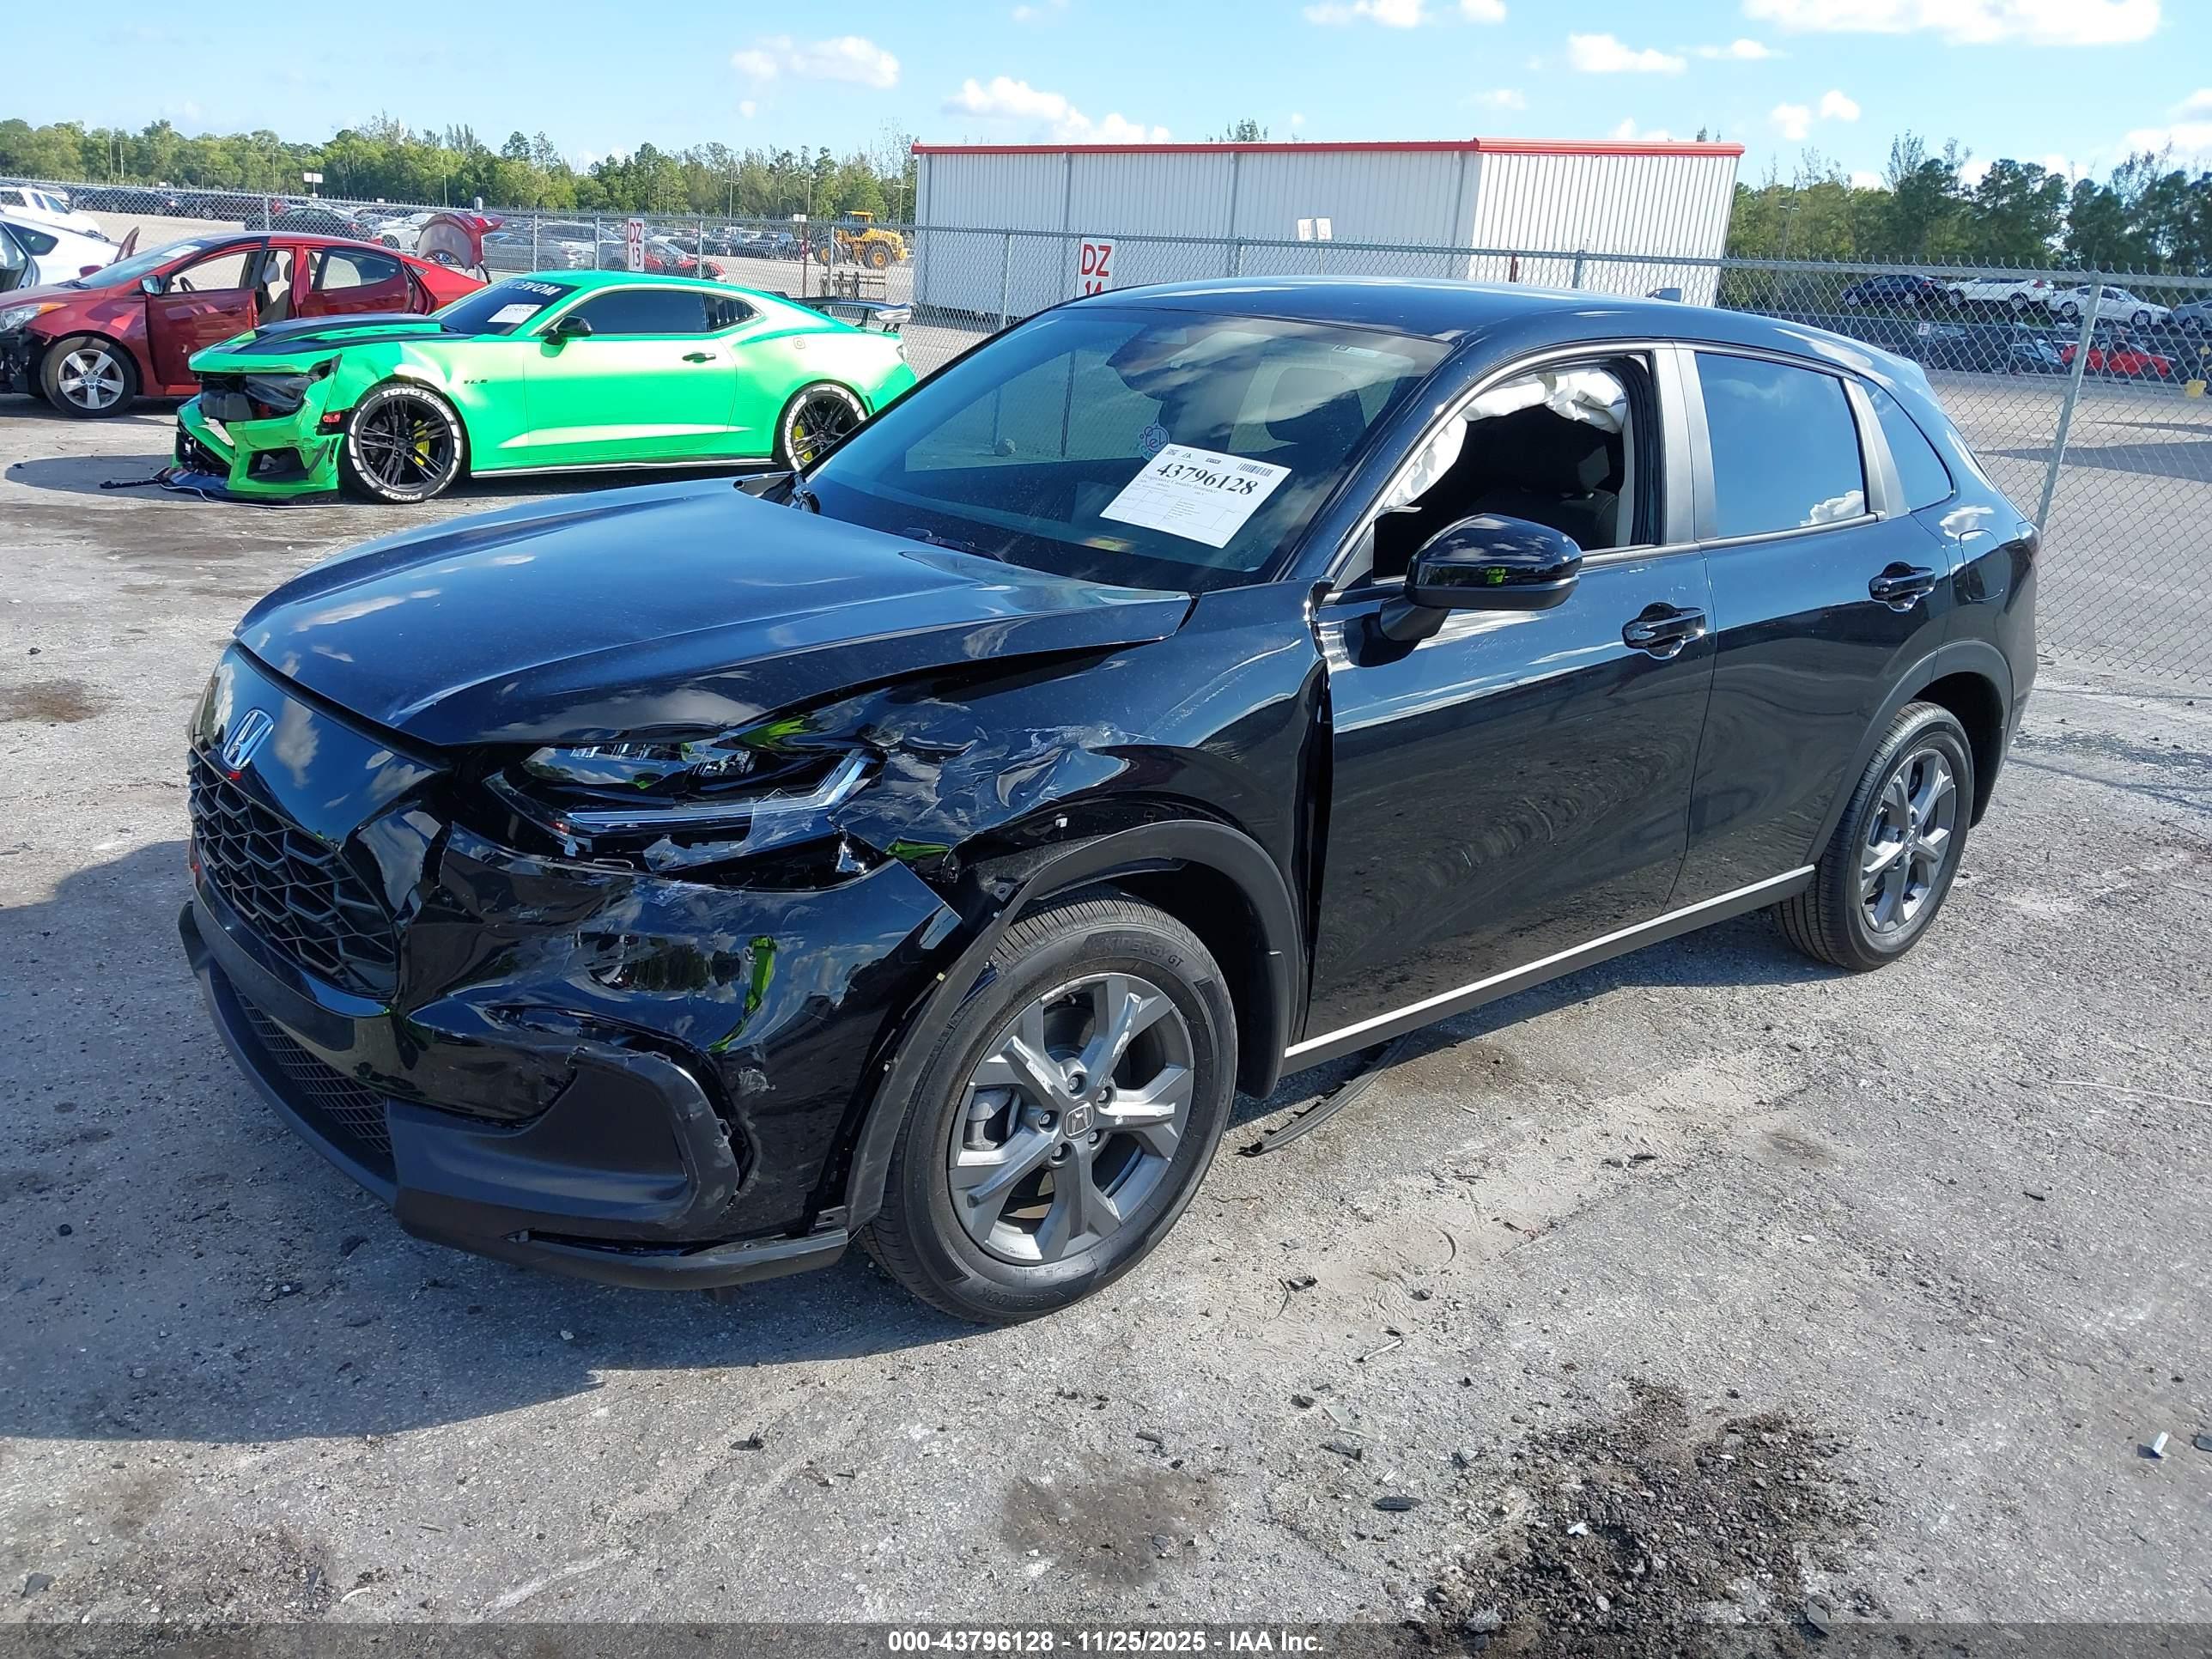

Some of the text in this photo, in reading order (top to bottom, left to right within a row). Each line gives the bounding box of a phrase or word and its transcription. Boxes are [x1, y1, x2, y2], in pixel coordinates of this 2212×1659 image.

[629, 222, 643, 244] DZ
[632, 246, 641, 267] 13
[1081, 244, 1112, 276] DZ
[1157, 462, 1259, 495] 43796128
[1168, 954, 1184, 968] GT
